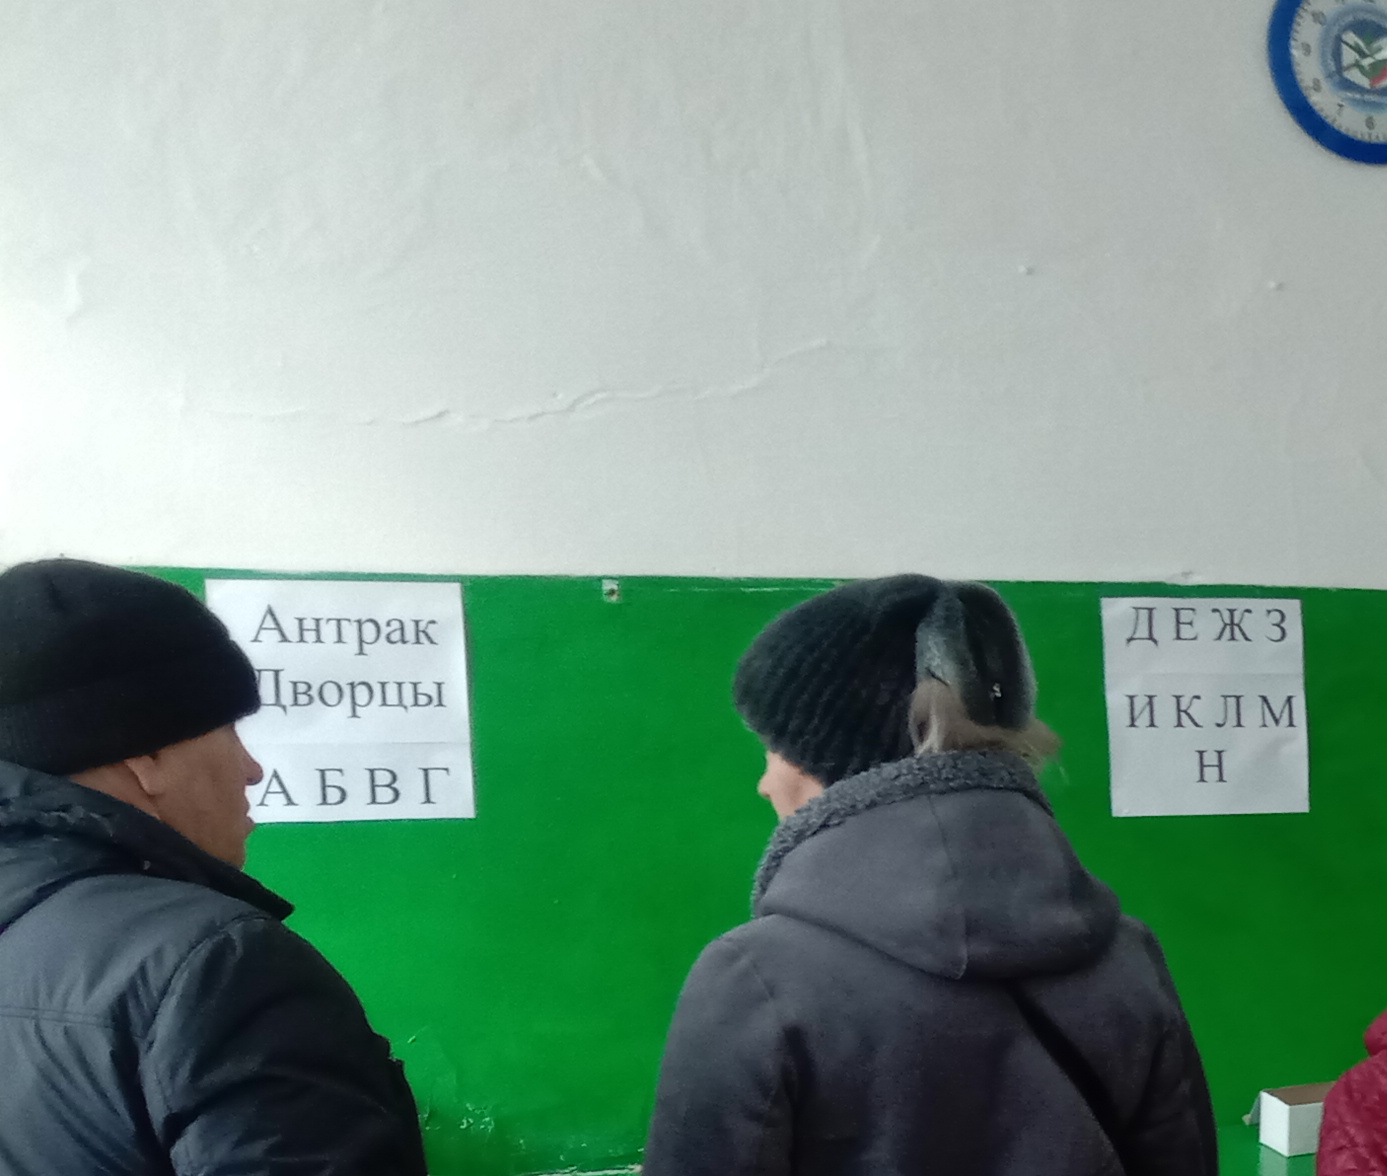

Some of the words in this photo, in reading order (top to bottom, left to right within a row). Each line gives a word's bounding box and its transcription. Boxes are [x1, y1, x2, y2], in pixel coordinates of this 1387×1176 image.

[250, 604, 439, 656] Антрак
[256, 668, 447, 719] Дворцы
[1195, 749, 1227, 783] Н
